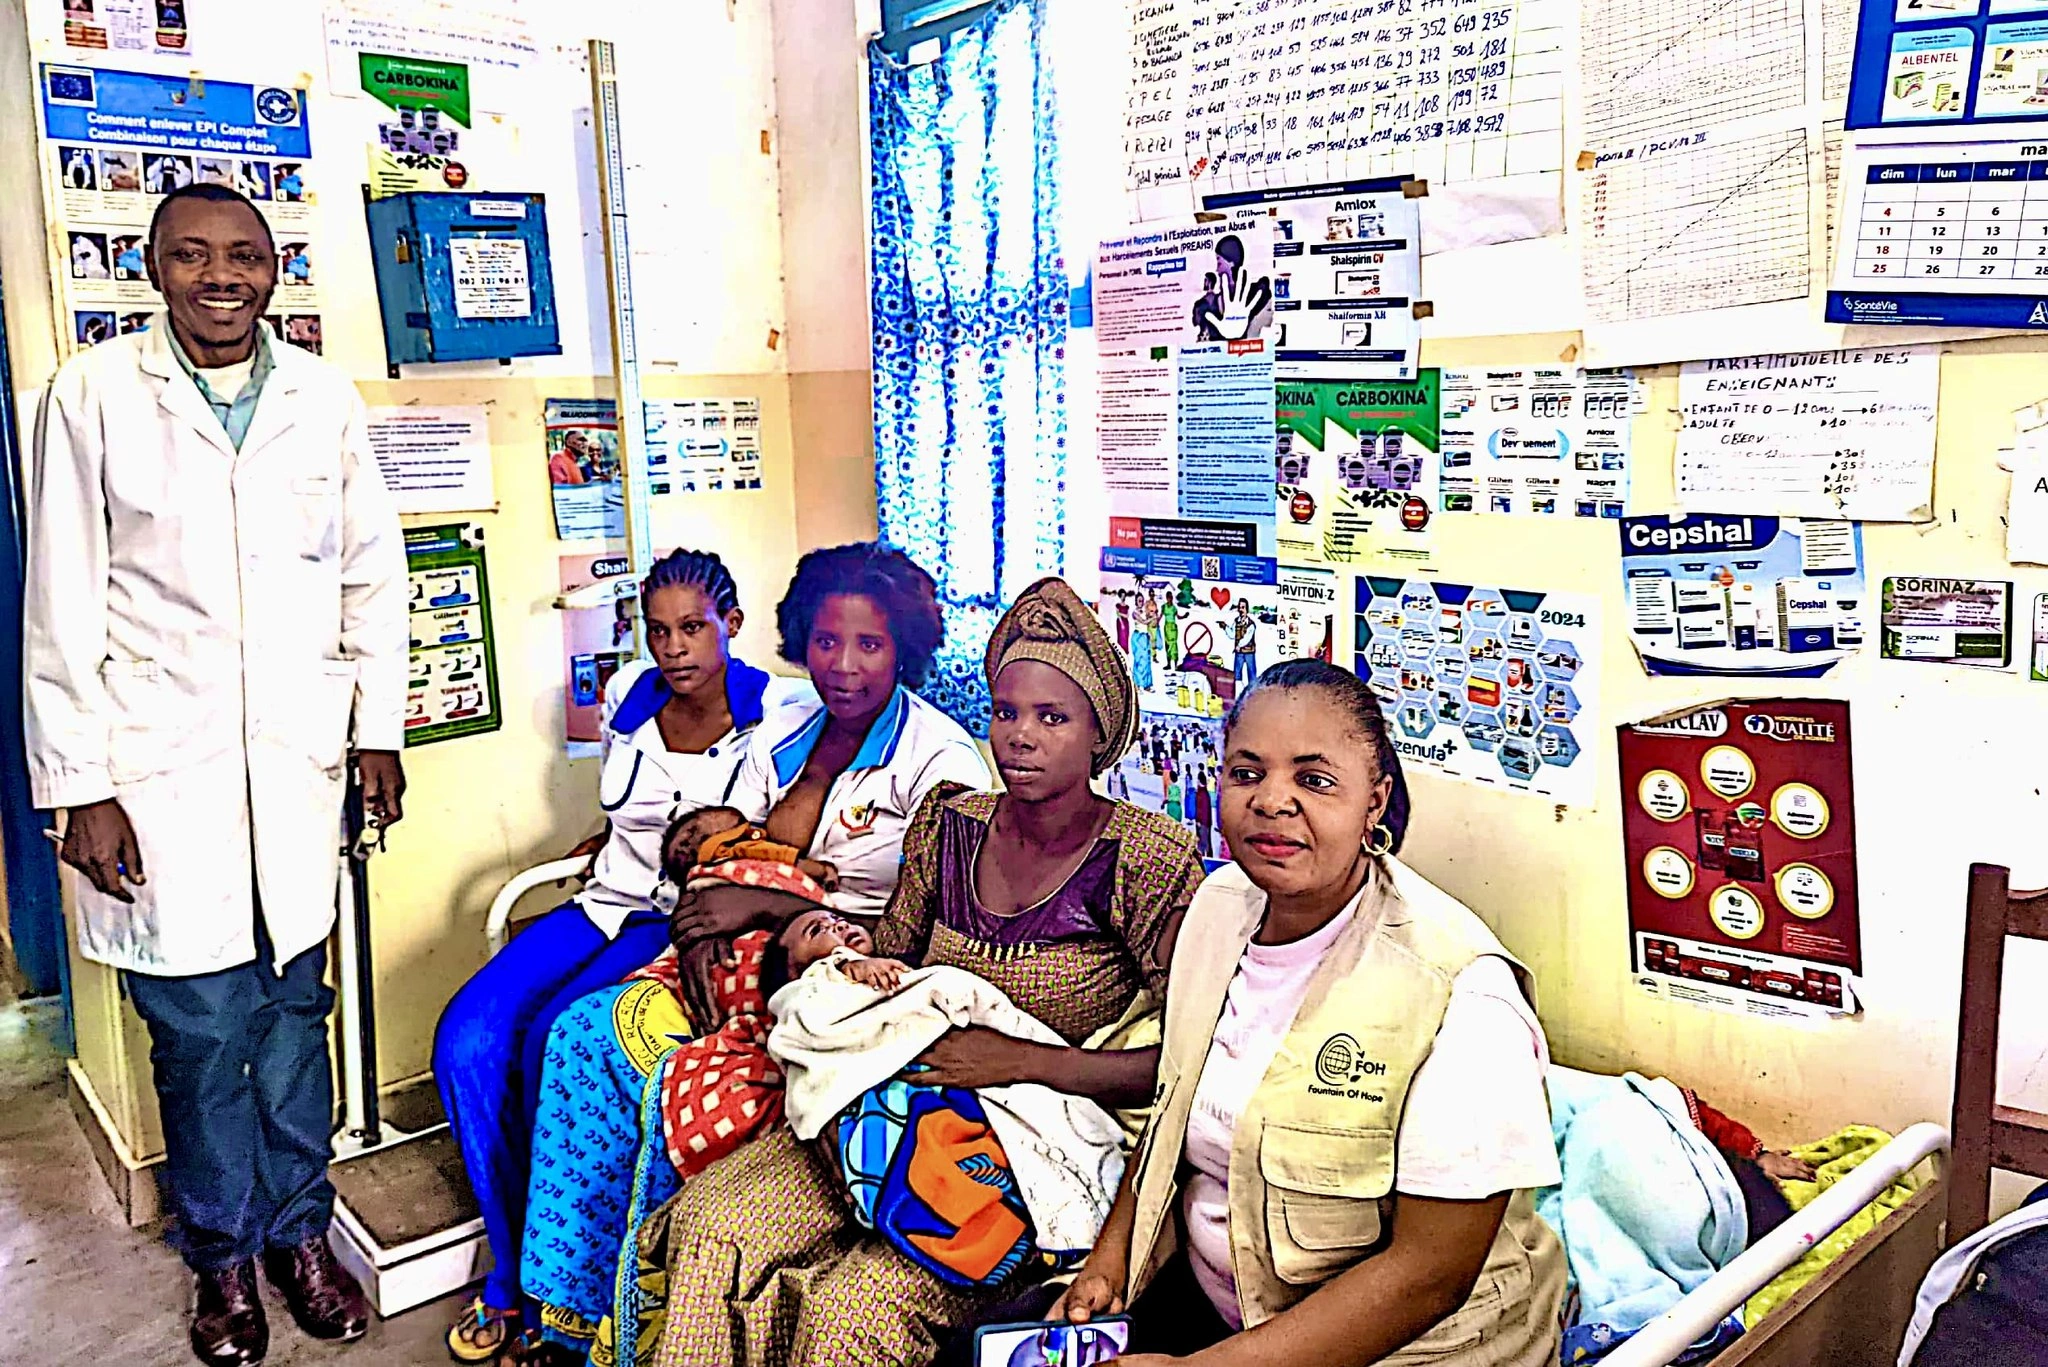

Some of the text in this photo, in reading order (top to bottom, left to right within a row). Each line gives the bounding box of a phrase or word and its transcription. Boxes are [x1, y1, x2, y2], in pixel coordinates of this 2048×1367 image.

[1420, 17, 1446, 39] 352
[1454, 14, 1476, 33] 649
[1482, 8, 1512, 32] 235
[1396, 50, 1412, 68] 29
[1420, 46, 1440, 64] 272
[1452, 42, 1474, 58] 501
[1480, 37, 1507, 60] 181
[1902, 52, 1958, 66] ALBENTEL
[374, 70, 458, 91] CARBOKINA
[1417, 70, 1440, 86] 733
[1480, 60, 1506, 80] 489
[1266, 118, 1277, 130] 33
[1284, 116, 1298, 130] 18
[1415, 94, 1440, 118] 108
[1481, 84, 1498, 101] 72
[87, 112, 268, 139] Comment enlever EPI Complet
[1474, 112, 1504, 134] 2572
[88, 127, 278, 154] Combinaison pour chaque étape
[1880, 167, 2016, 179] dim lun mar
[1334, 199, 1376, 212] Amlox
[1884, 207, 2000, 216] 4 5 6
[1228, 221, 1246, 232] Abus
[1878, 226, 2000, 236] 11 12 13
[1373, 253, 1384, 264] CV
[1876, 246, 1998, 256] 18 19 20
[1872, 264, 1887, 273] 25
[1925, 264, 1940, 274] 26
[1979, 266, 1996, 274] 27
[1854, 300, 1898, 311] SantéVie
[1336, 389, 1428, 406] CARBOKINA
[1629, 518, 1752, 549] Cepshal
[1896, 578, 1976, 595] SORINAZ
[1790, 600, 1827, 610] Cepshal
[1540, 610, 1586, 628] 2024
[1355, 1061, 1386, 1076] FOH
[572, 1069, 598, 1091] RCC
[1308, 1084, 1384, 1102] Fountain Of Hope
